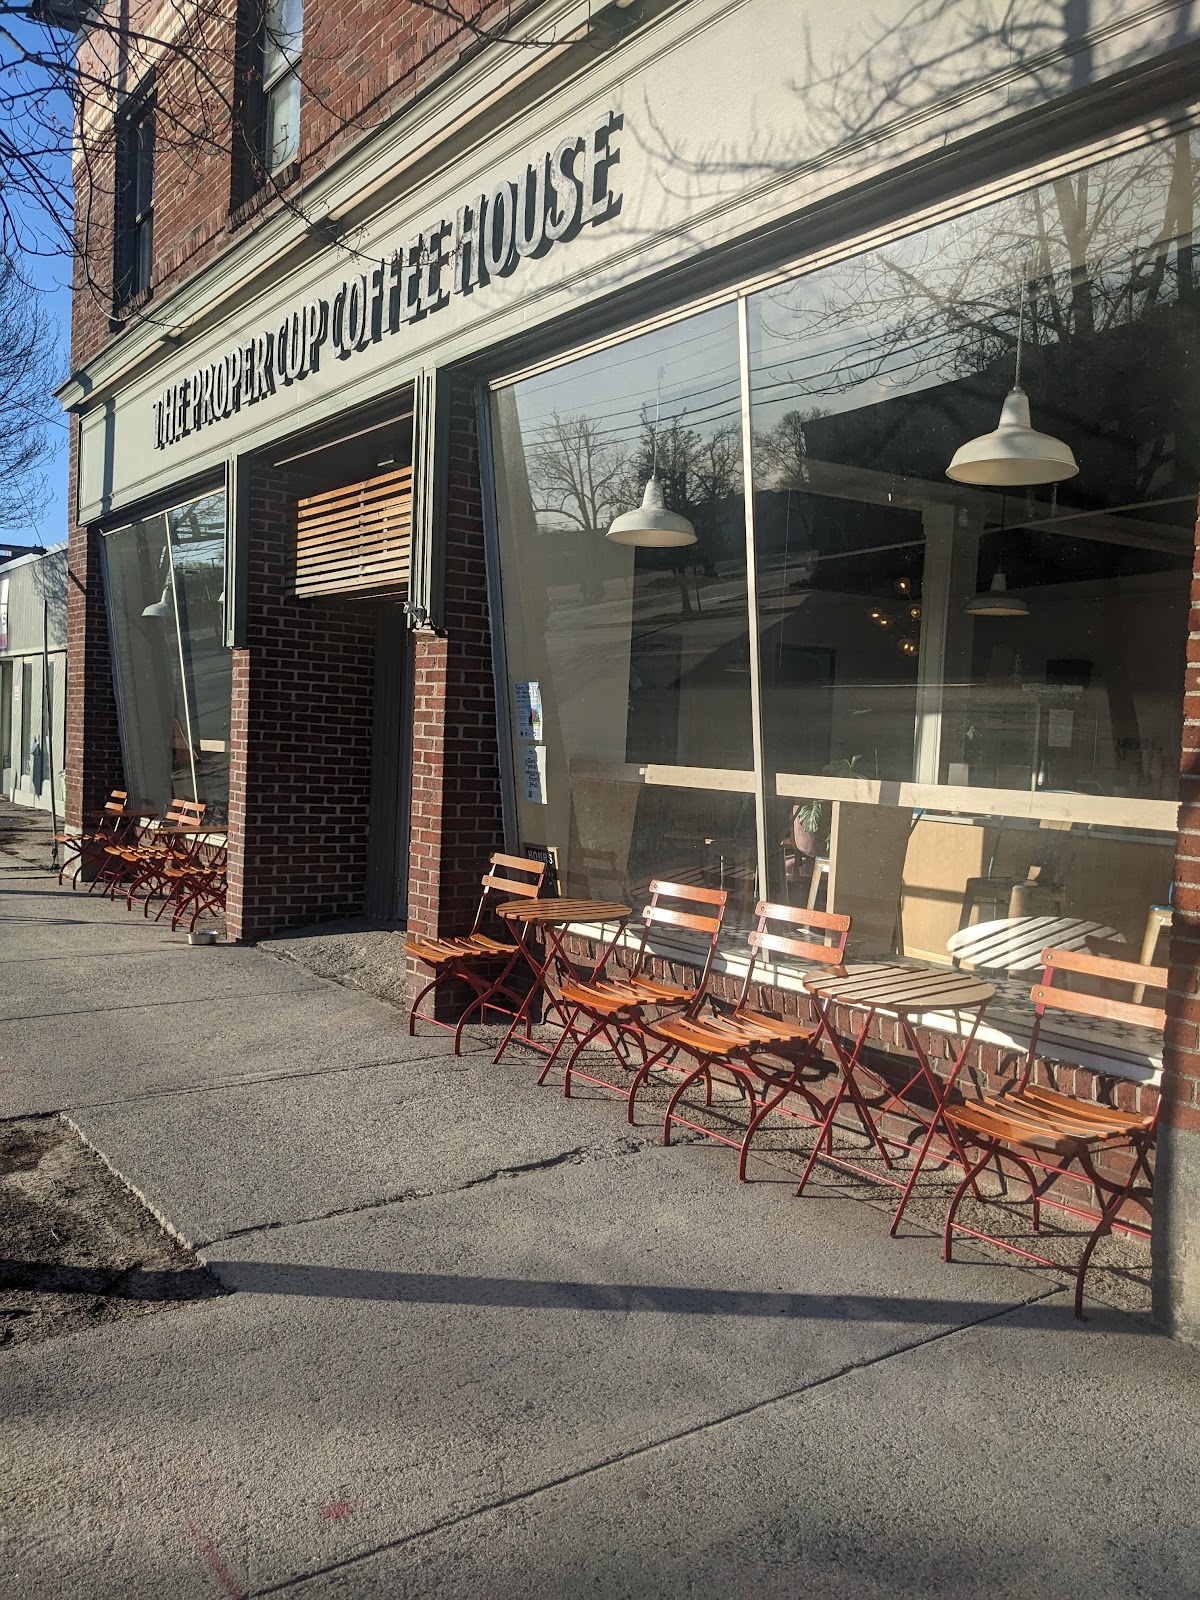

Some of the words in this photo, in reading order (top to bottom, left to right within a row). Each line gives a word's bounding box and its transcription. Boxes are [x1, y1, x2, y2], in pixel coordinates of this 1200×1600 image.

[153, 379, 189, 450] THE
[185, 331, 272, 430] PROPER
[272, 298, 323, 386] CUP
[327, 219, 444, 359] COFFEE
[453, 110, 616, 295] HOUSE
[527, 849, 554, 865] HOURS
